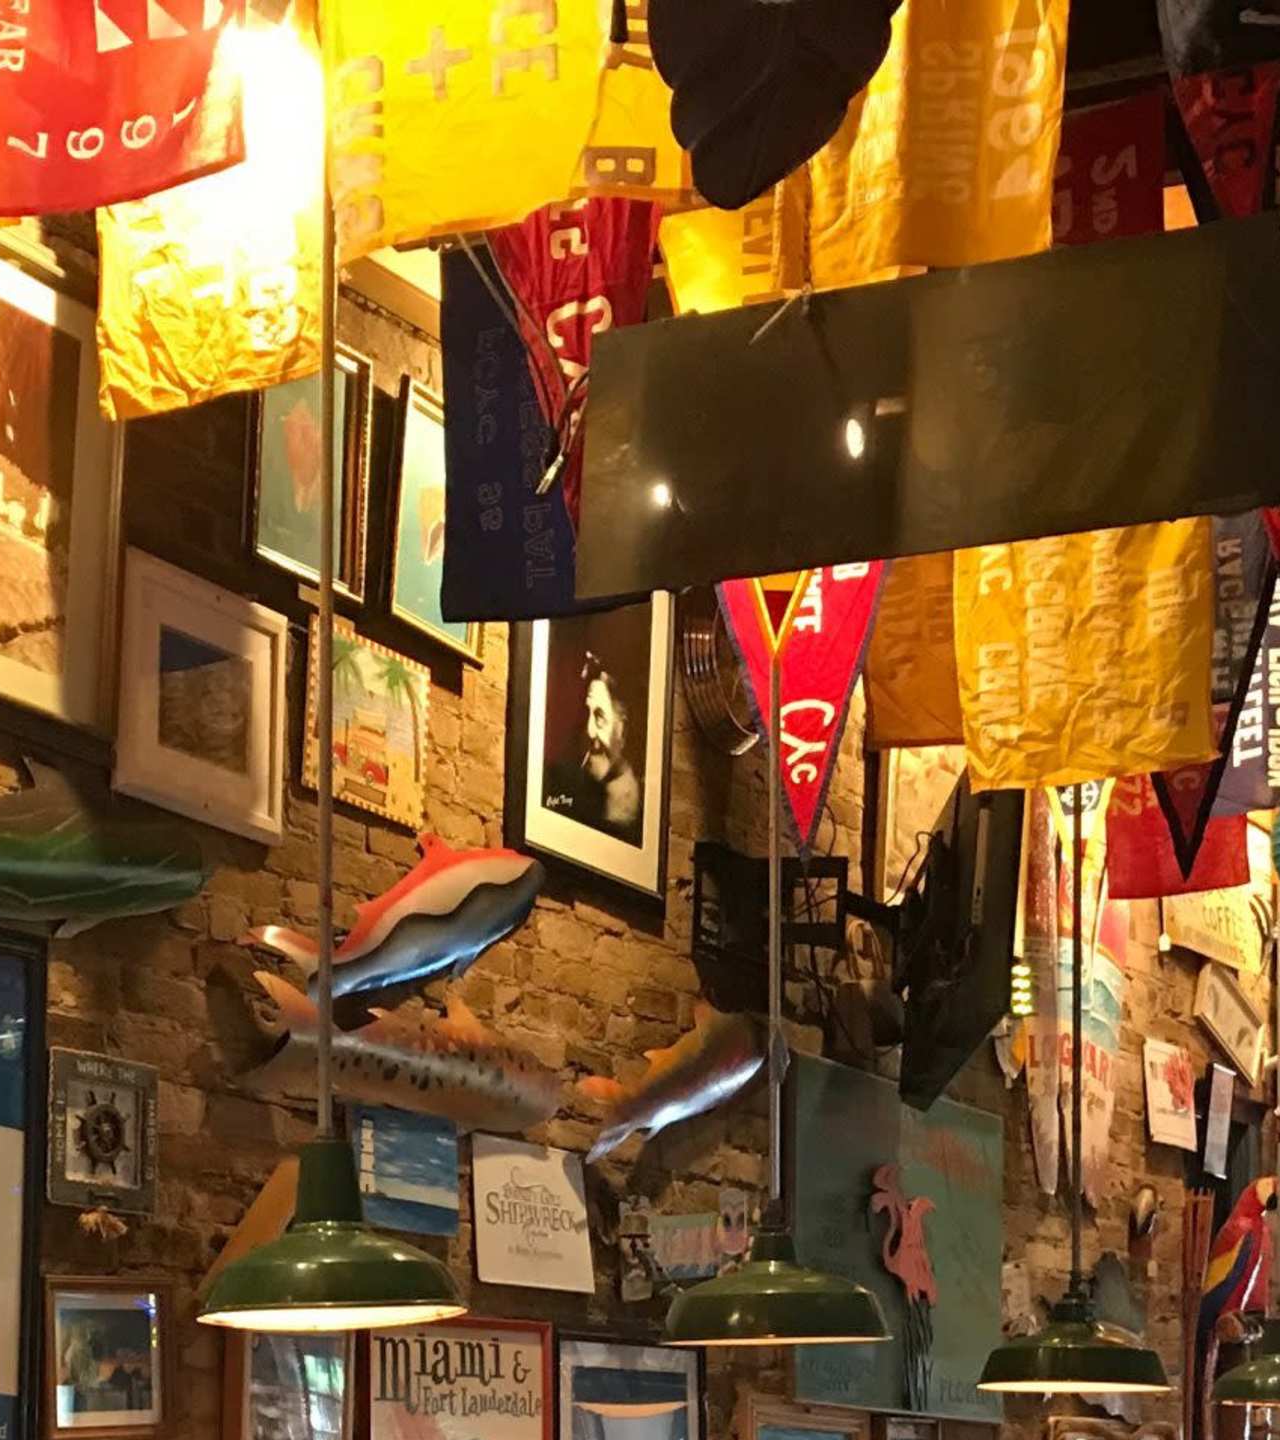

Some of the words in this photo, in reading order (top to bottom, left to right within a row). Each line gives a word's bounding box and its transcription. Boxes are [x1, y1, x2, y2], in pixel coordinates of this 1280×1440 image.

[373, 1332, 506, 1416] miami
[512, 1350, 531, 1384] &
[422, 1385, 457, 1417] Fort
[460, 1386, 543, 1418] Lauderdale
